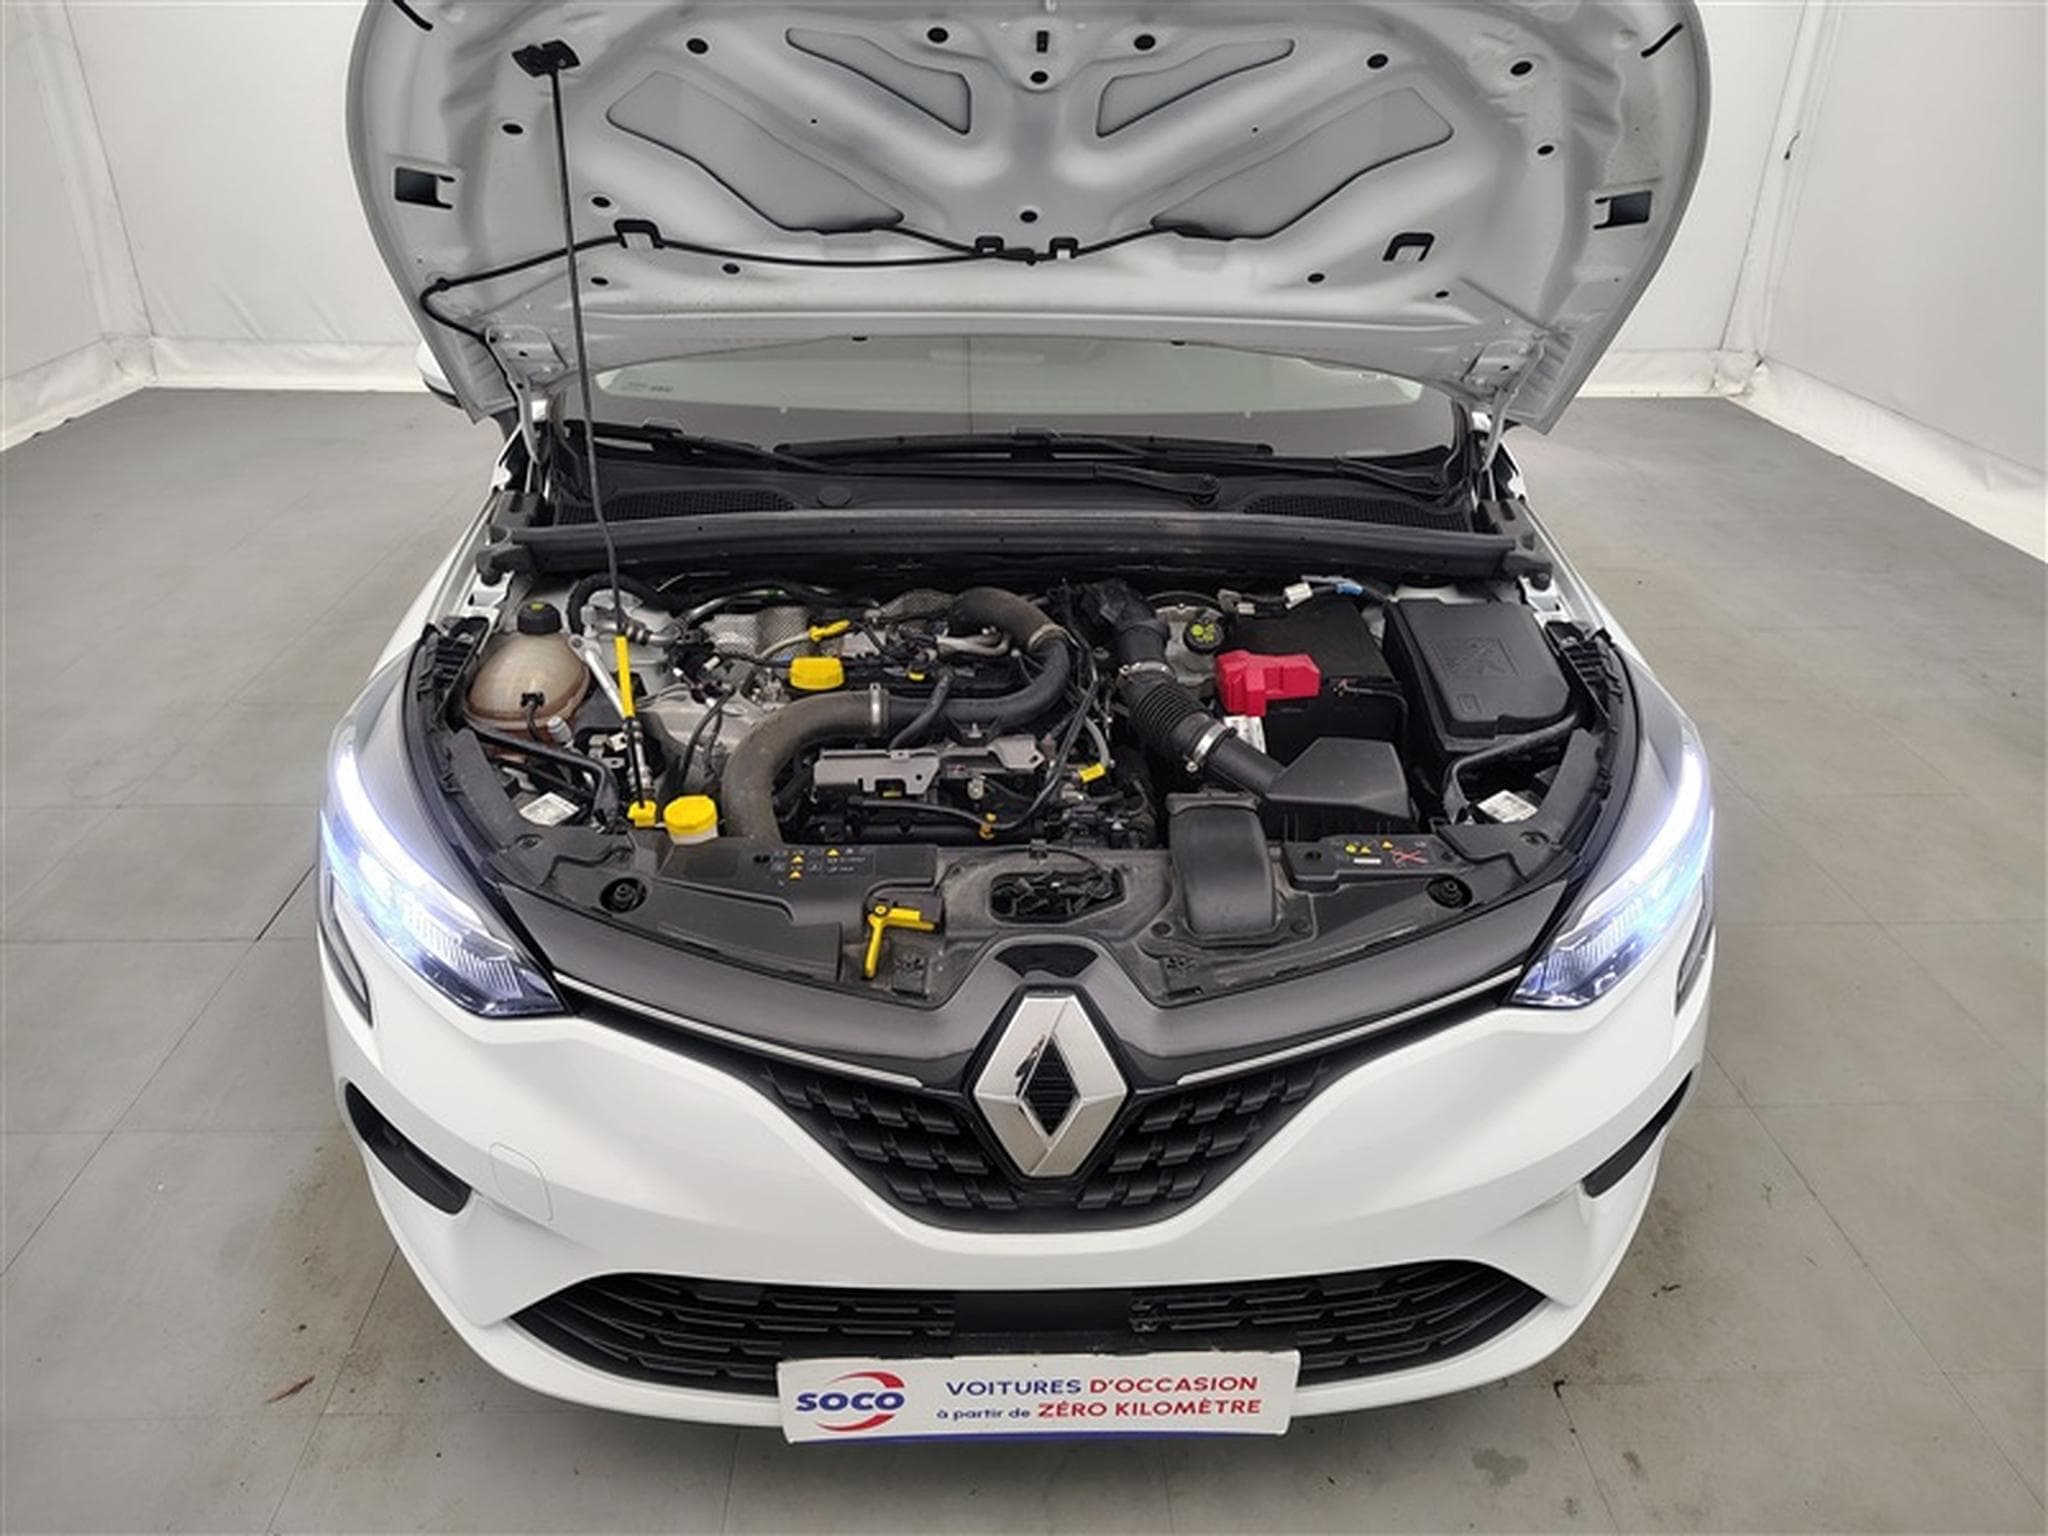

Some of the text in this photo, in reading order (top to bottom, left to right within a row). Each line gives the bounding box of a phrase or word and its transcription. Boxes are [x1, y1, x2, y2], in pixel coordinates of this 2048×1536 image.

[946, 1376, 1258, 1396] VOITURES D'OCCASION
[796, 1392, 905, 1412] SOCO
[936, 1398, 1262, 1422] à partir de ZÉRO KILOMÈTRE
